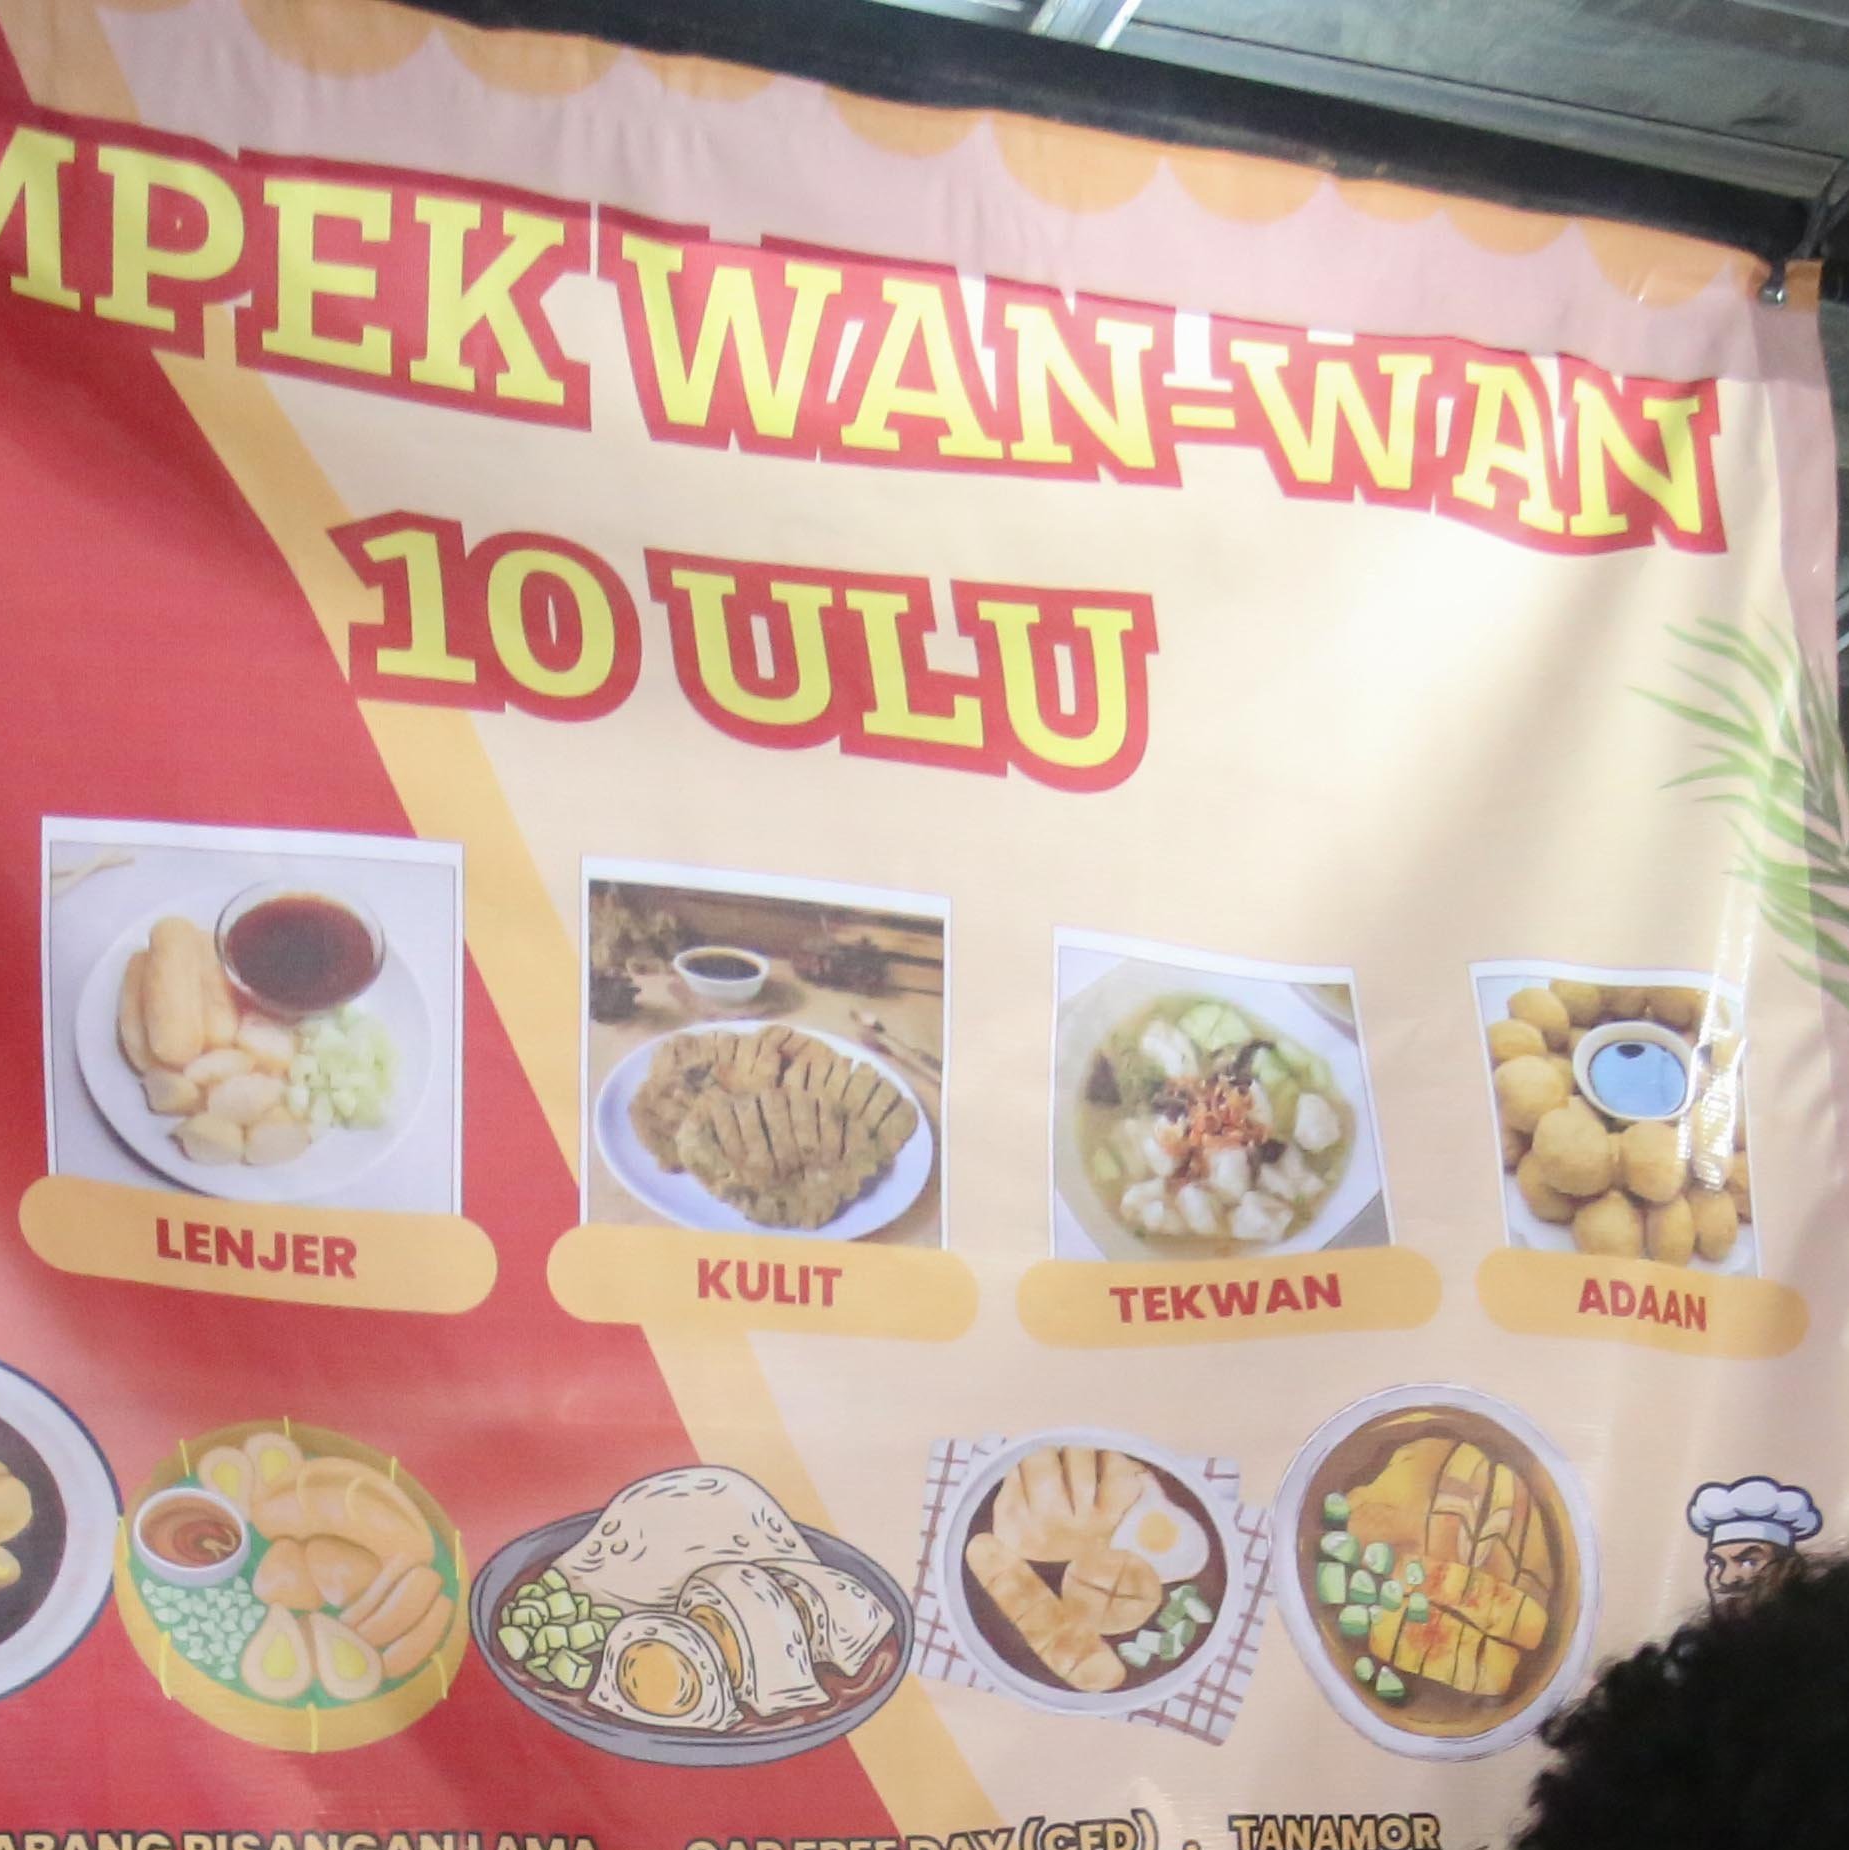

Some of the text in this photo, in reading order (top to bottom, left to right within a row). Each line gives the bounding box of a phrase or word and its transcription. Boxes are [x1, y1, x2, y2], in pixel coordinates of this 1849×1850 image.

[621, 230, 1704, 540] WAN-WAN
[359, 528, 1136, 770] 10 ULU
[154, 1216, 358, 1280] LENJER
[695, 1258, 843, 1308] KULIT
[1108, 1272, 1342, 1325] TEKWAN
[1576, 1278, 1708, 1332] ADAAN
